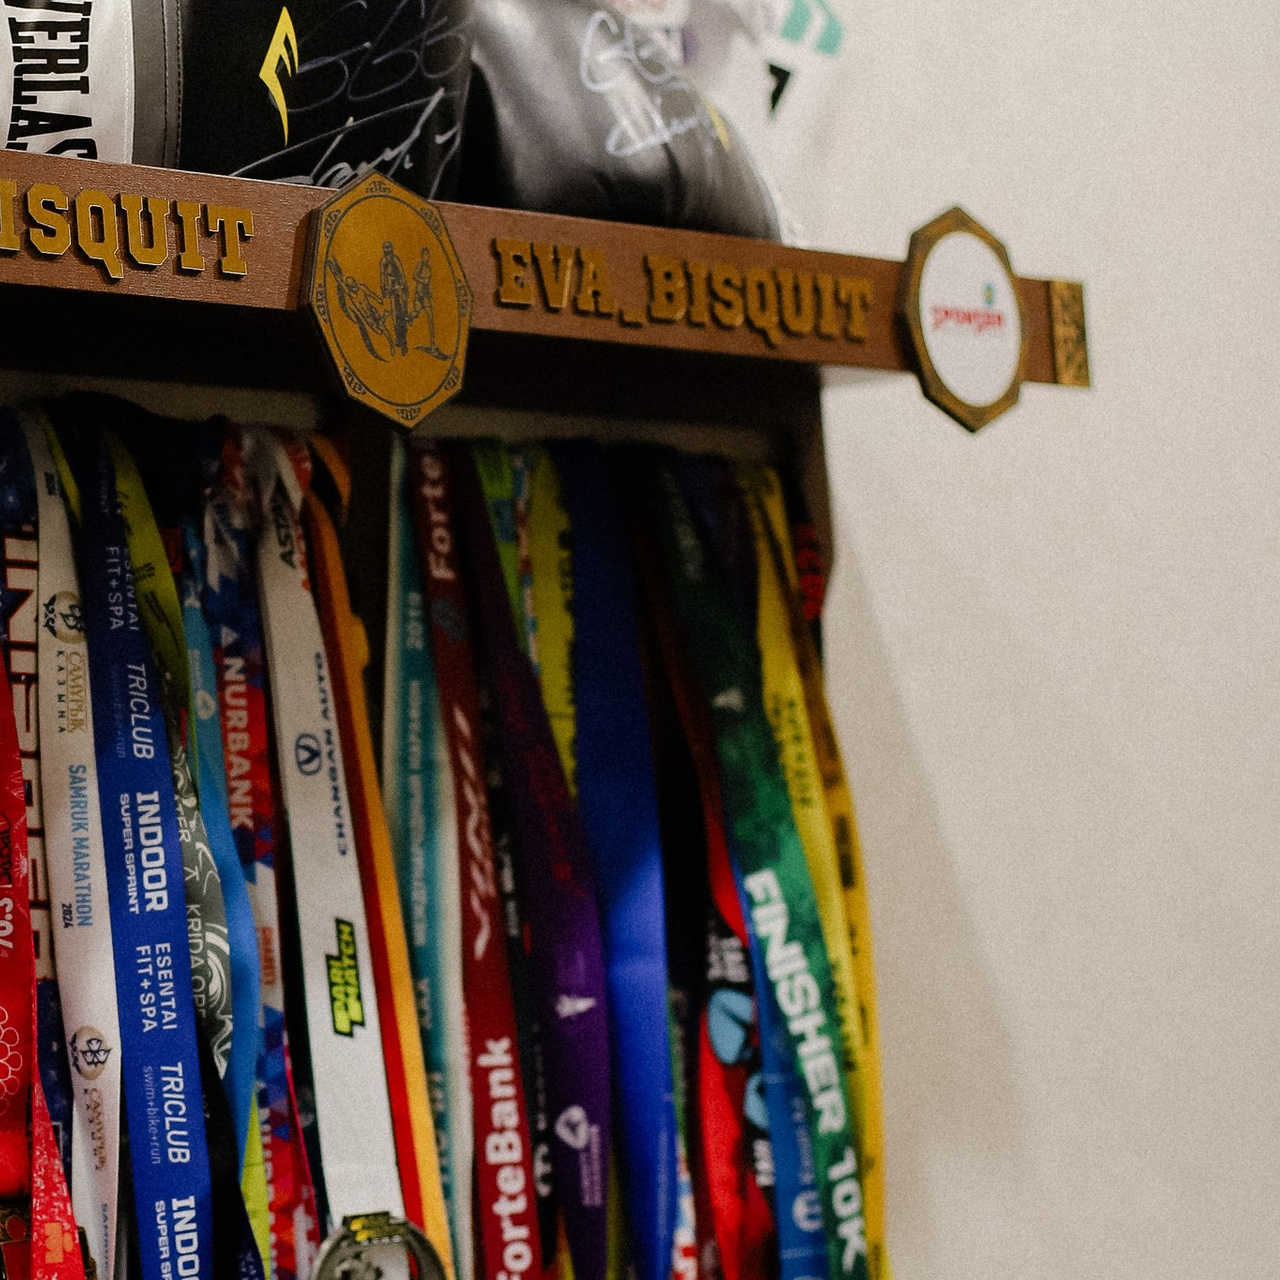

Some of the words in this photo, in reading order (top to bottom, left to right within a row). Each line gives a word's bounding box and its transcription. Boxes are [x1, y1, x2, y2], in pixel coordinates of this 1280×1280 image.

[492, 237, 873, 348] EVA_BISQUIT
[105, 546, 124, 631] FIT+SPA
[127, 663, 156, 761] TRICLUB
[314, 652, 329, 723] AUTO
[223, 656, 254, 830] NURBANK
[68, 763, 91, 832] SAMRUK
[120, 793, 134, 844] SUPER
[321, 729, 348, 856] CHANGAN
[73, 833, 93, 927] MARATHON
[124, 848, 140, 915] SPRINT
[136, 790, 169, 913] INDOOR
[61, 903, 73, 929] 2024
[136, 945, 158, 1034] FIT+SPA
[156, 942, 178, 1032] ESENTAI
[143, 1065, 161, 1165] swim+bike+run
[161, 1062, 191, 1164] TRICLUB
[743, 868, 847, 1136] FINISHER
[827, 1144, 868, 1273] 10K
[154, 1200, 168, 1250] SUPER
